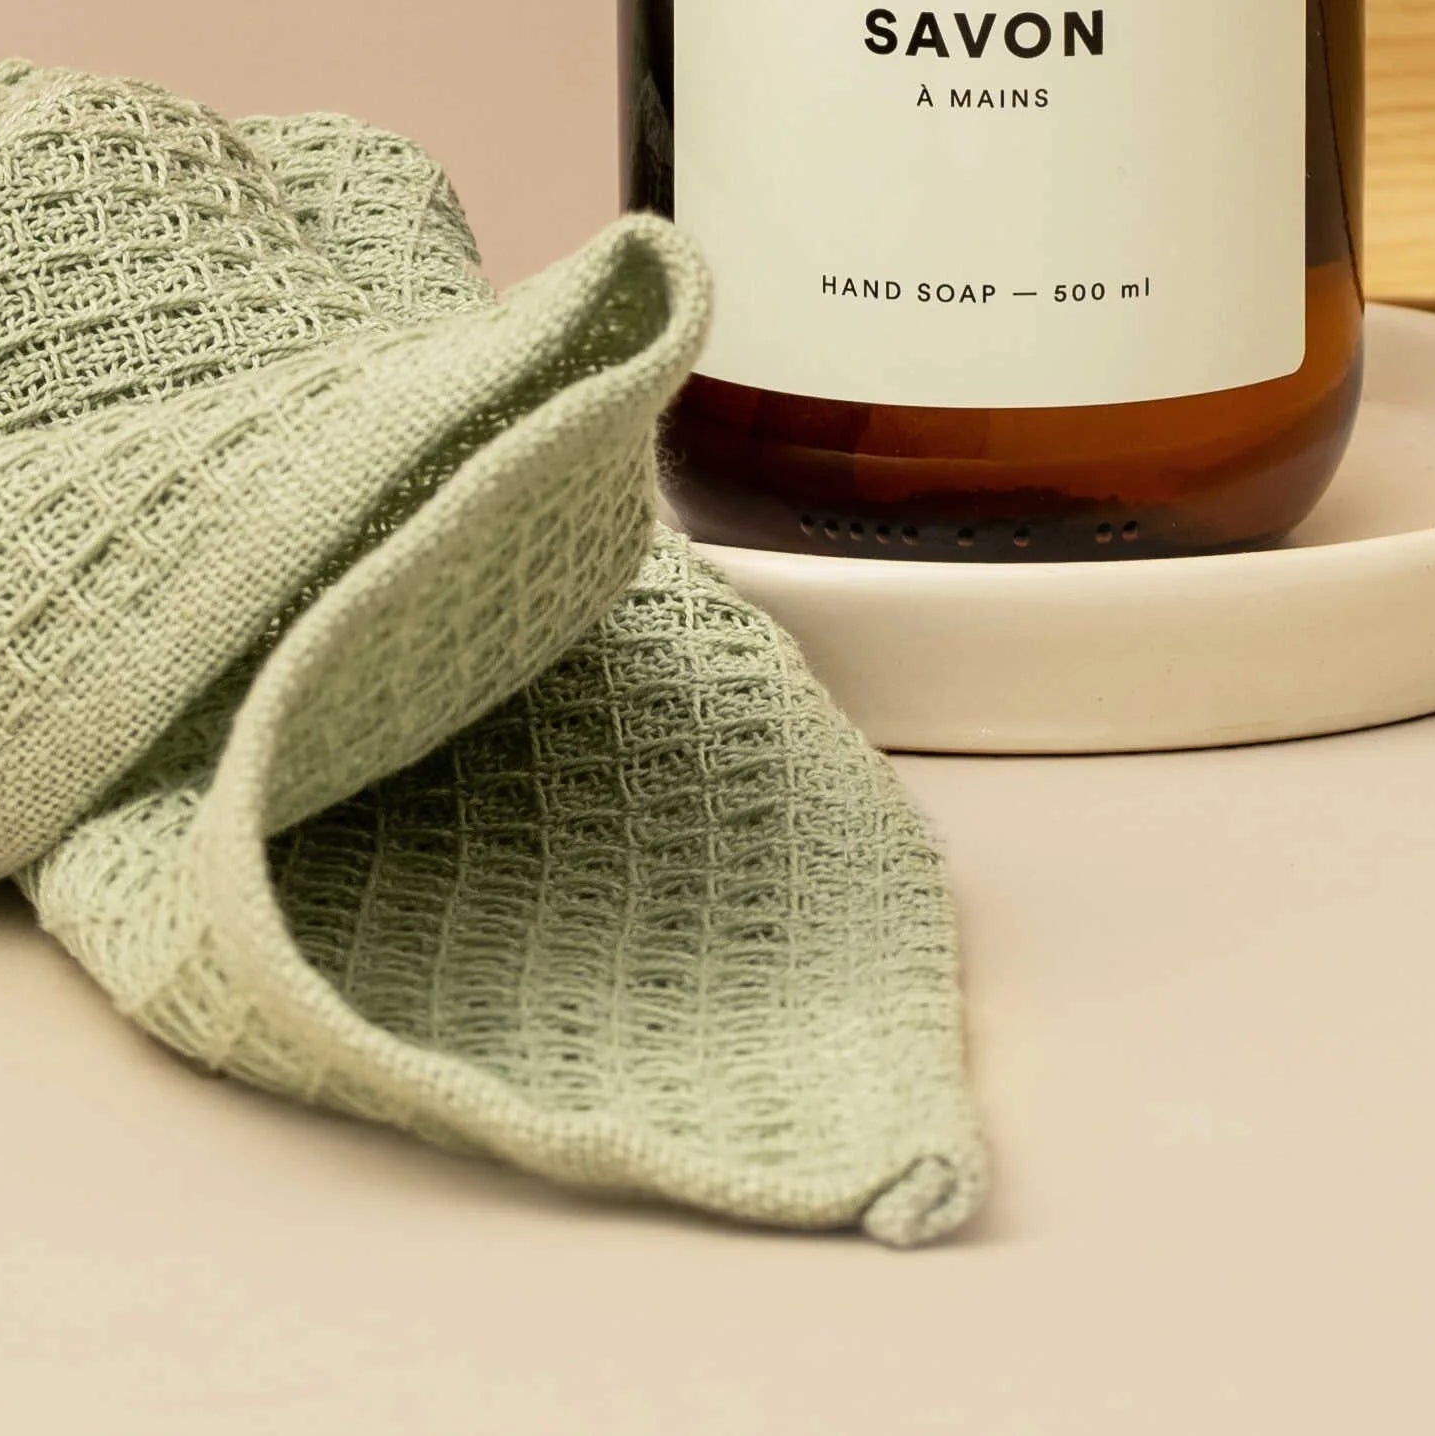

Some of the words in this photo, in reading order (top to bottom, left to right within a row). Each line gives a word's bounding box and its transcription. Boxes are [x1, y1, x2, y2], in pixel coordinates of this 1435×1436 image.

[864, 8, 1104, 59] SAVON
[916, 83, 934, 108] À
[950, 88, 1049, 109] MAINS
[822, 274, 902, 300] HAND
[917, 282, 996, 304] SOAP
[1053, 282, 1106, 303] 500
[1121, 276, 1151, 299] ml
